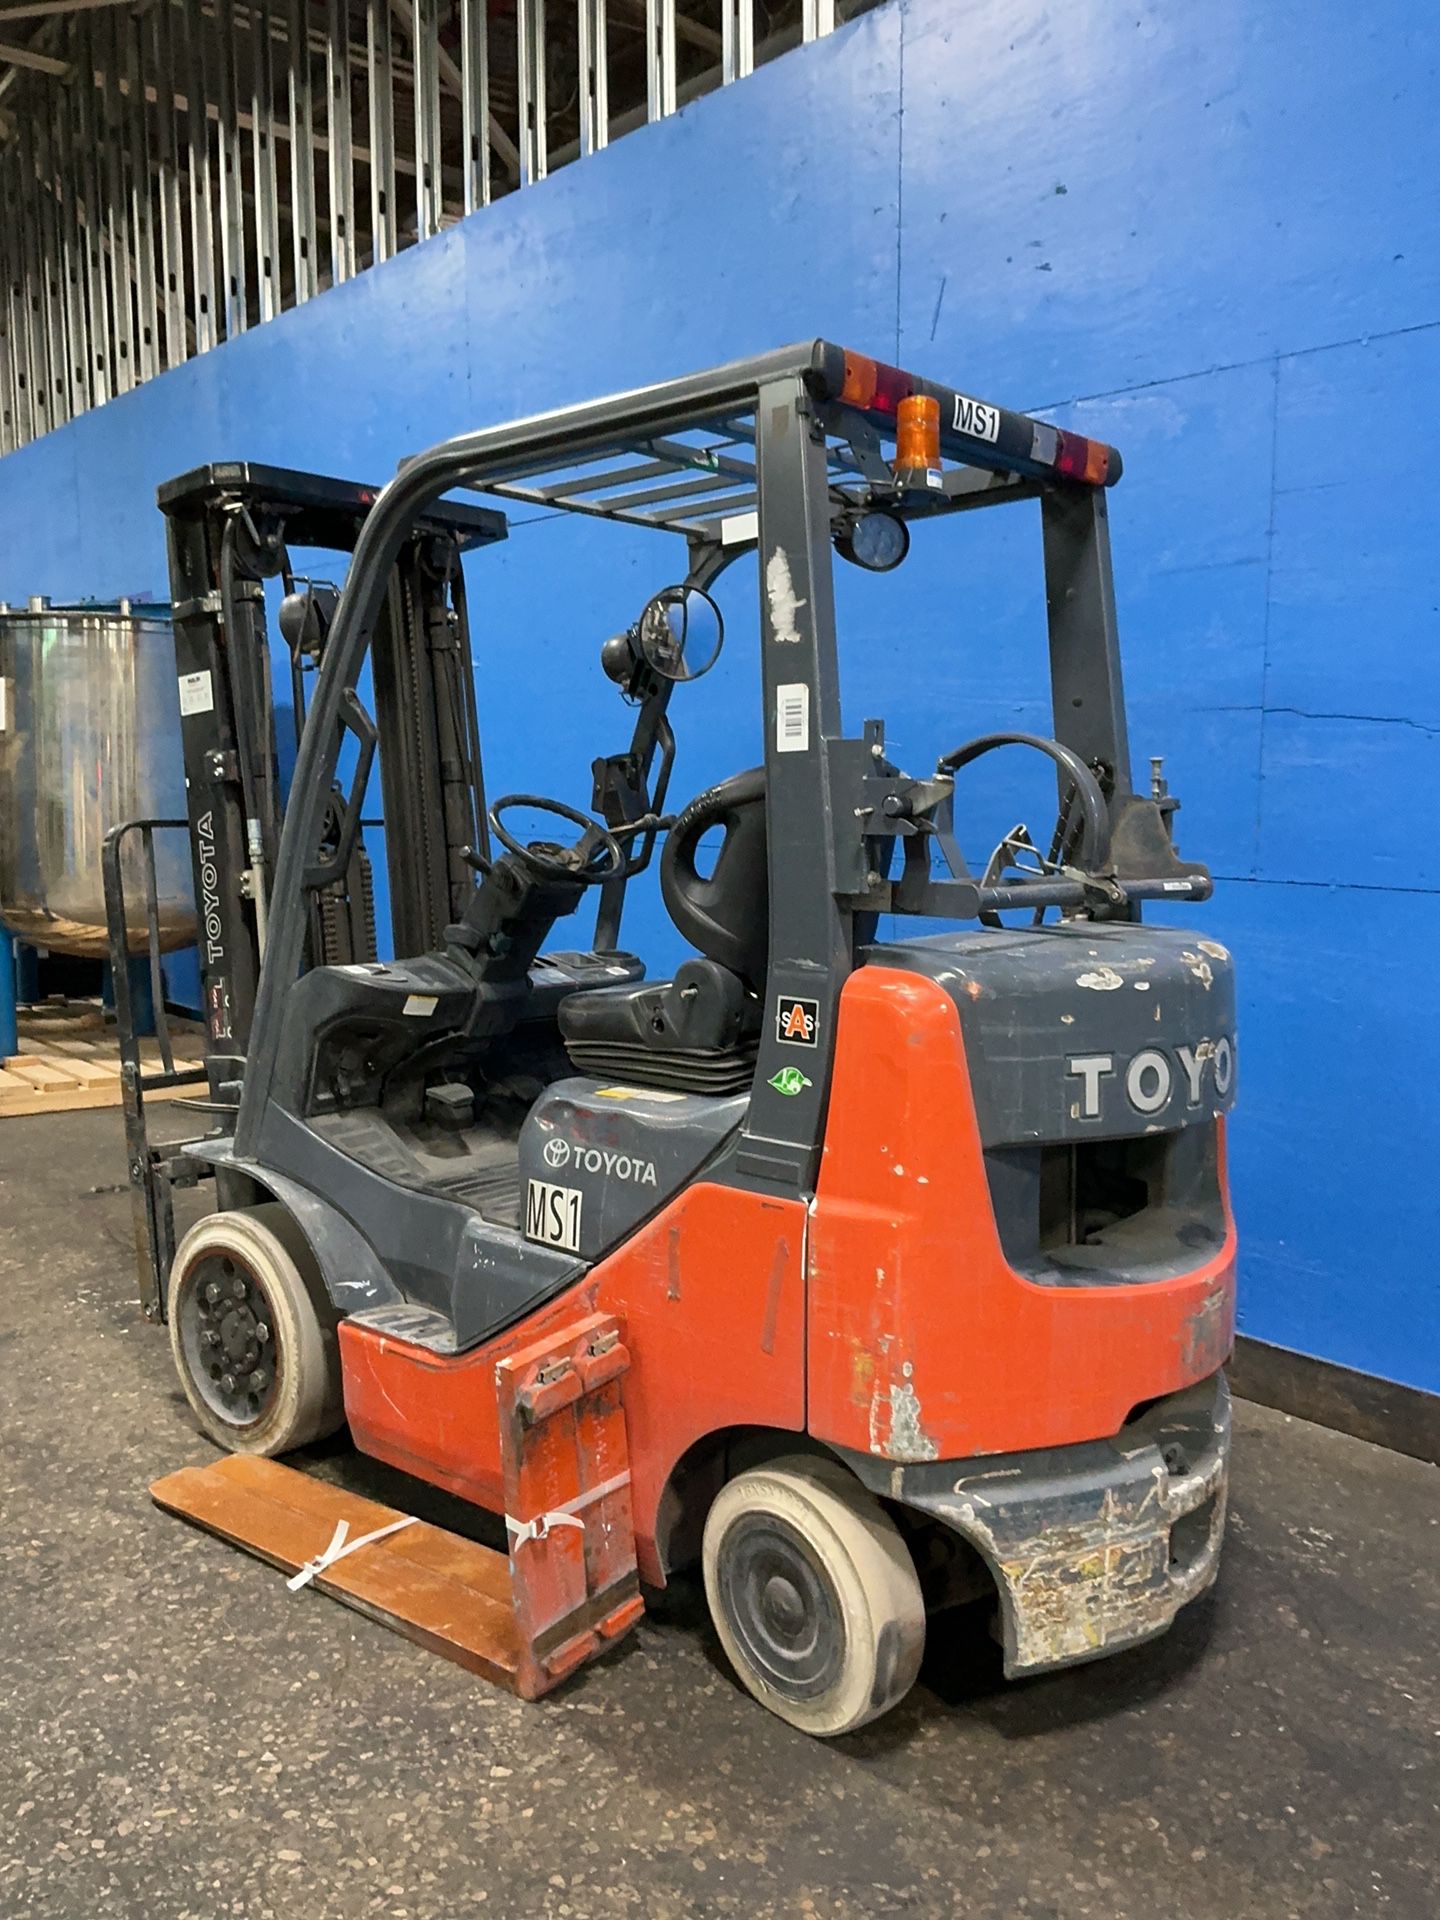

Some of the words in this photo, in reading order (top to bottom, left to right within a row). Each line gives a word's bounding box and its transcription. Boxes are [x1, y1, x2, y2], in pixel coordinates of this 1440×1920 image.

[956, 398, 996, 439] MS1
[198, 810, 224, 965] TOYOTA
[780, 1003, 815, 1041] SAS
[573, 1146, 658, 1187] TOYOTA
[527, 1183, 580, 1248] MS1
